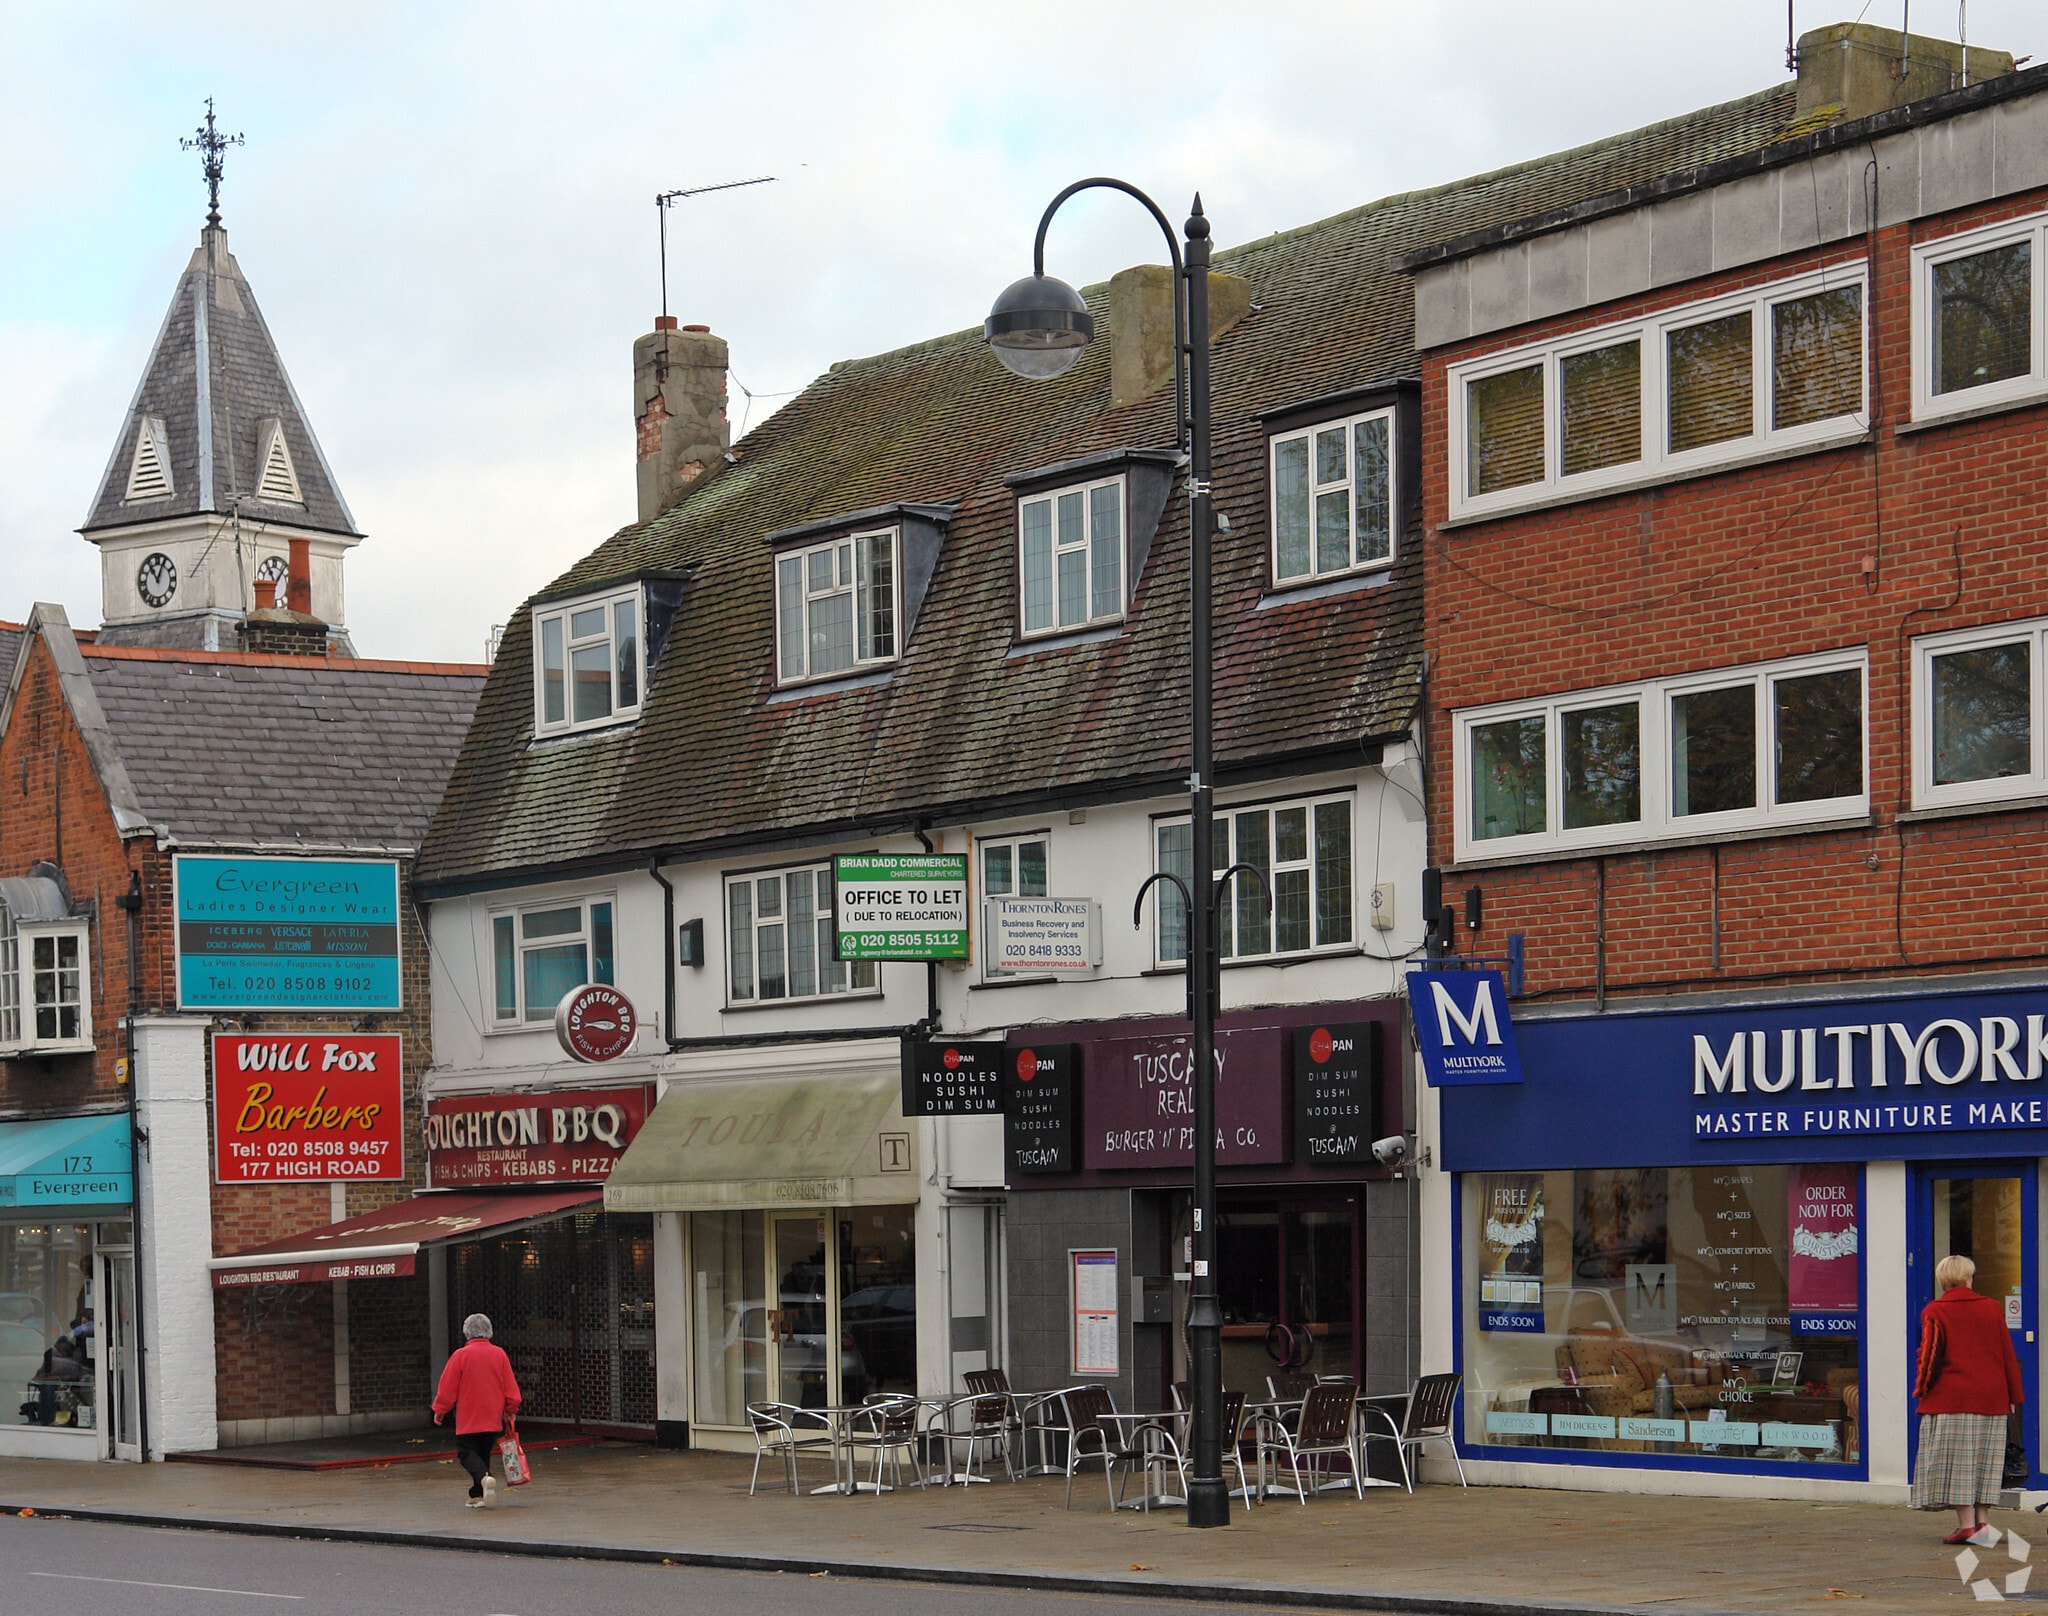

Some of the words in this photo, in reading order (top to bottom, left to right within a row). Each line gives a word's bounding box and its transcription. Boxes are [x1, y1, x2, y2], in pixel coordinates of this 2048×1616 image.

[840, 859, 869, 867] BRIAN
[872, 859, 897, 867] DADD
[900, 859, 961, 867] COMMERCIAL
[216, 869, 359, 901] Evergreen
[845, 891, 902, 904] OFFICE
[908, 890, 927, 904] TO
[934, 890, 961, 904] LET
[186, 900, 246, 911] Ladies
[255, 902, 335, 914] Designer
[345, 904, 387, 913] Wear
[879, 912, 891, 920] TO
[896, 911, 962, 922] RELOCATION)
[1036, 920, 1069, 929] Recovery
[209, 927, 263, 935] ICEBERG
[271, 927, 312, 936] VERSACE
[323, 928, 336, 937] LA
[337, 928, 369, 937] PERLA
[1009, 931, 1045, 939] Insolvency
[326, 942, 368, 951] MISSONI
[861, 935, 885, 946] 020
[889, 935, 921, 945] 8505
[925, 934, 958, 945] 5112
[1006, 945, 1025, 956] 020
[1029, 945, 1051, 956] 8418
[1055, 945, 1081, 956] 9333
[287, 961, 331, 969] Fragrances
[345, 961, 375, 969] Lingerie
[209, 977, 236, 990] Tel.
[245, 977, 276, 990] 020
[284, 977, 326, 990] 8508
[334, 978, 371, 990] 9102
[571, 991, 619, 1031] LOUGHTON
[1429, 981, 1503, 1046] M
[576, 1034, 593, 1052] FISH
[603, 1035, 626, 1055] CHIPS
[1133, 1048, 1227, 1088] TUSCAY
[1443, 1056, 1505, 1068] MULTIYORK
[922, 1072, 997, 1082] NOODLES
[1309, 1072, 1328, 1081] DIM
[1336, 1070, 1358, 1079] SUM
[936, 1086, 985, 1096] SUSHI
[1016, 1090, 1033, 1098] DIM
[1039, 1088, 1059, 1096] SUM
[1316, 1089, 1350, 1098] SUSHI
[236, 1082, 380, 1133] Barbers
[926, 1100, 954, 1110] DIM
[965, 1099, 996, 1110] SUM
[1022, 1104, 1052, 1113] SUSHI
[1307, 1105, 1360, 1116] NOODLES
[1696, 1112, 1789, 1133] MASTER
[1804, 1105, 1952, 1131] FURNITURE
[1969, 1101, 2048, 1124] MAKE
[552, 1104, 622, 1148] BBQ
[682, 1111, 827, 1147] TOULA
[1015, 1120, 1060, 1130] NOODLES
[1106, 1129, 1155, 1152] BURGER
[1180, 1127, 1226, 1150] PIA
[1236, 1128, 1261, 1148] CO.
[1309, 1135, 1358, 1156] TUSCANY
[230, 1143, 261, 1157] Tel:
[267, 1142, 298, 1156] 020
[303, 1142, 344, 1155] 8508
[349, 1141, 389, 1154] 9457
[477, 1149, 527, 1160] RESTAURANT
[885, 1139, 905, 1166] T
[1016, 1148, 1059, 1166] TUSCANY
[64, 1157, 92, 1172] 173
[240, 1162, 270, 1176] 177
[276, 1161, 321, 1175] HIGH
[327, 1161, 380, 1174] ROAD
[434, 1165, 449, 1179] FISH
[453, 1164, 458, 1178] &
[462, 1164, 490, 1178] CHIPS
[503, 1160, 556, 1176] KEBABS
[33, 1181, 118, 1195] Evergreen
[608, 1189, 622, 1201] 169
[776, 1187, 792, 1198] 020
[795, 1185, 816, 1197] 8508
[817, 1184, 838, 1196] 7606
[1806, 1186, 1846, 1200] ORDER
[1495, 1189, 1527, 1205] FREE
[1799, 1205, 1828, 1218] NOW
[1831, 1204, 1854, 1217] FOR
[1802, 1236, 1852, 1256] CHRISTMAS
[220, 1273, 249, 1285] LOUGHTON
[250, 1273, 261, 1282] BBQ
[262, 1270, 299, 1281] RESTAURANT
[329, 1267, 349, 1277] KEBAB
[354, 1266, 368, 1276] FISH
[370, 1265, 374, 1275] &
[375, 1263, 395, 1274] CHIPS
[1636, 1273, 1665, 1309] M
[1489, 1316, 1508, 1326] ENDS
[1511, 1316, 1534, 1327] SOON
[1801, 1319, 1824, 1330] ENDS
[1828, 1319, 1856, 1330] SOON
[1719, 1391, 1753, 1402] CHOICE
[1560, 1421, 1572, 1429] JIM
[1574, 1421, 1608, 1430] DICKENS
[1628, 1421, 1676, 1437] Sanderson
[1767, 1431, 1828, 1441] LINWOOD
